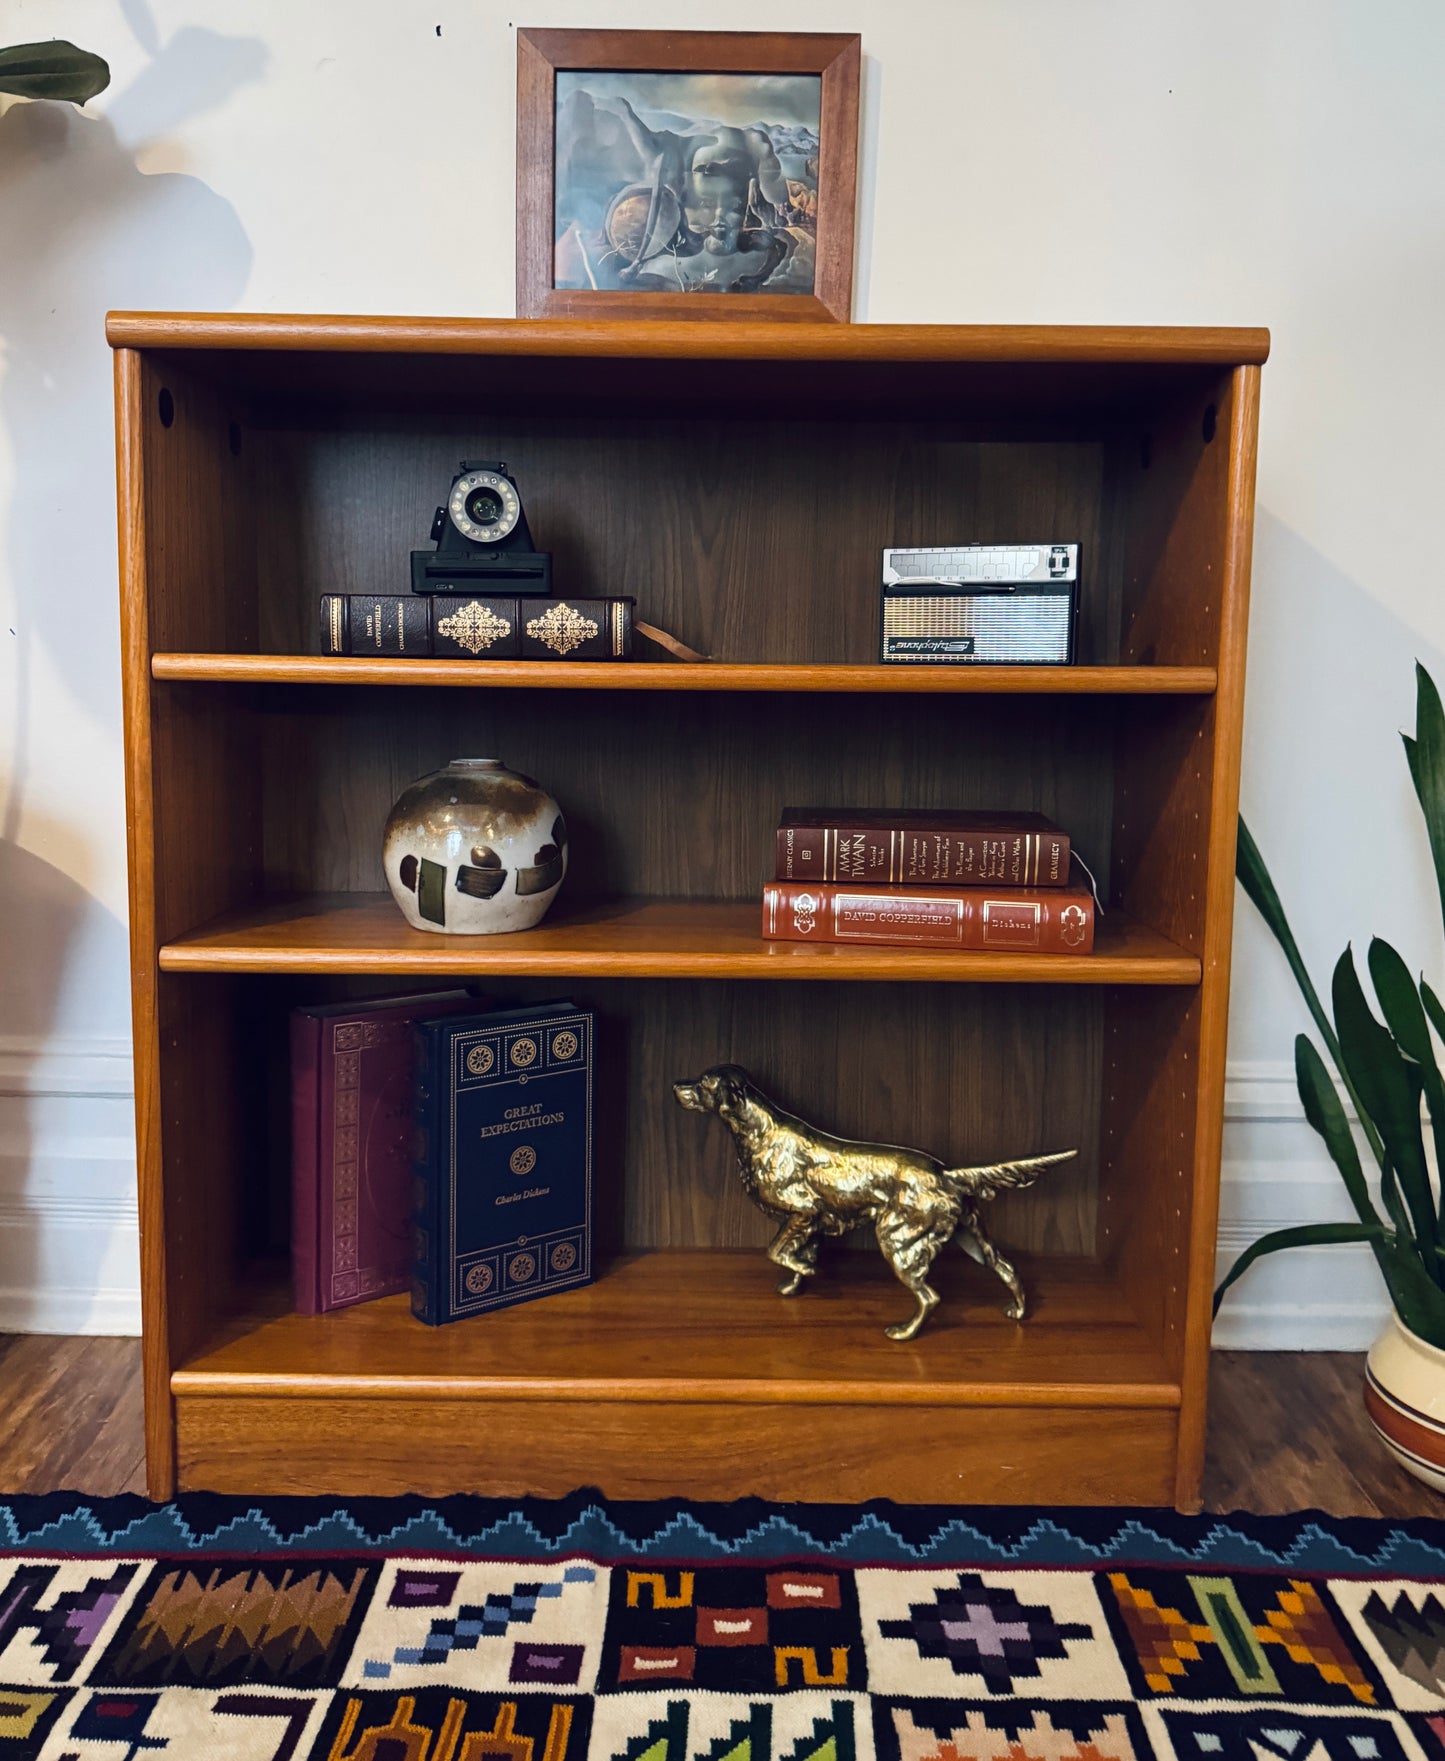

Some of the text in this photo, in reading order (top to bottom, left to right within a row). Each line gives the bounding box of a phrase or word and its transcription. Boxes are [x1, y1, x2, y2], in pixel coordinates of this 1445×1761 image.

[895, 639, 970, 652] Stylophone
[786, 829, 794, 855] CLASSICS
[910, 838, 918, 866] Adventures
[920, 840, 928, 858] Sawyer
[998, 841, 1006, 858] Court
[1012, 838, 1021, 856] Works
[839, 839, 851, 872] MARK
[852, 834, 866, 877] TWAIN
[869, 845, 877, 868] Selected
[933, 842, 941, 869] Adventures
[1050, 842, 1060, 880] GRAMERCY
[844, 910, 953, 927] DAVID COPPERFIELD
[992, 918, 1031, 930] Dickens
[504, 1103, 543, 1120] GREAT
[480, 1111, 564, 1138] EXPECTATIONS
[495, 1186, 550, 1206] Charles Dickens
